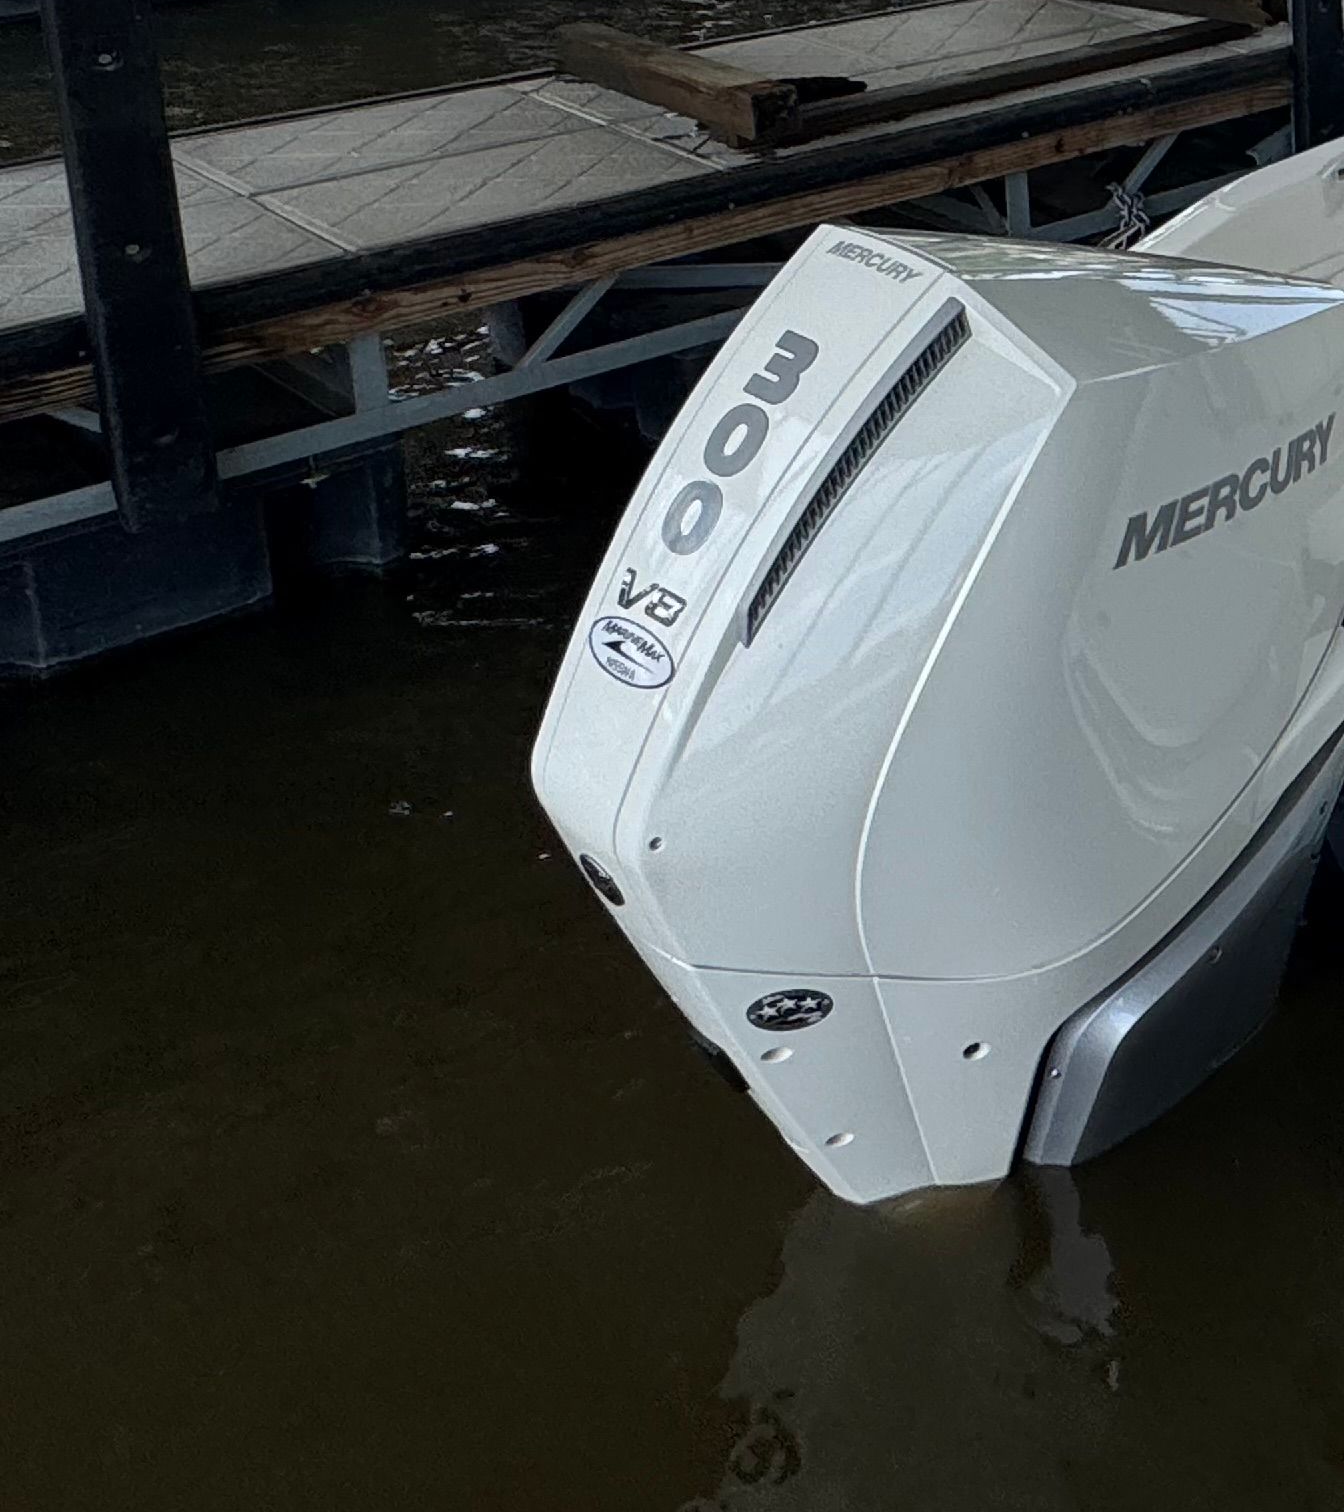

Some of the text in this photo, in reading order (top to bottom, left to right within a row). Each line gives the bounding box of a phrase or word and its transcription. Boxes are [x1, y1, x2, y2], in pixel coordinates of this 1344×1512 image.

[827, 241, 922, 283] MERCURY
[662, 330, 819, 555] 300
[1112, 411, 1336, 570] MERCURY
[617, 567, 687, 627] V8
